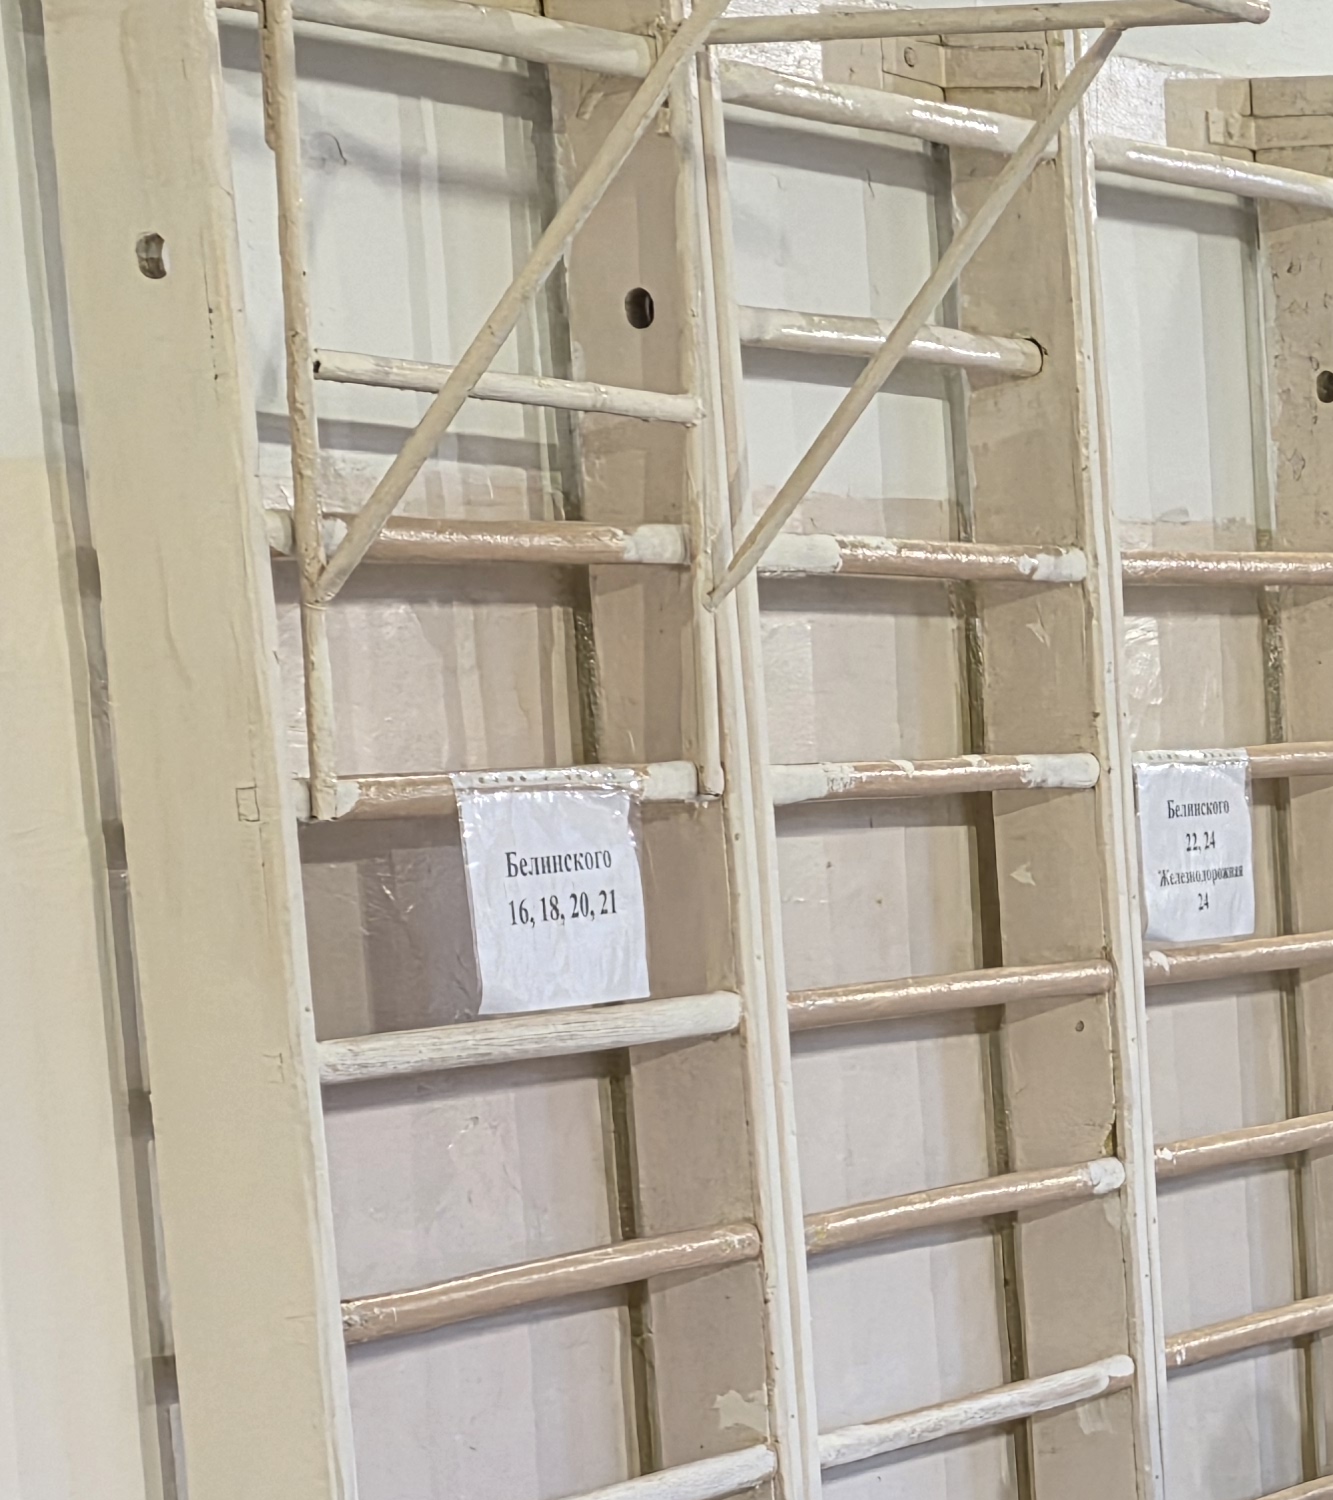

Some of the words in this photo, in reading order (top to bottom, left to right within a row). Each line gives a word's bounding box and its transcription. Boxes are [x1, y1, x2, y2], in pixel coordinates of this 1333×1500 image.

[1167, 800, 1230, 819] Белинского
[1186, 832, 1202, 854] 22,
[1204, 830, 1216, 850] 24
[505, 850, 612, 878] Белинского
[1158, 864, 1244, 887] Железнодорожная
[508, 898, 536, 928] 16,
[540, 895, 566, 926] 18,
[569, 891, 596, 922] 20,
[599, 889, 618, 915] 21
[1198, 892, 1210, 911] 24
